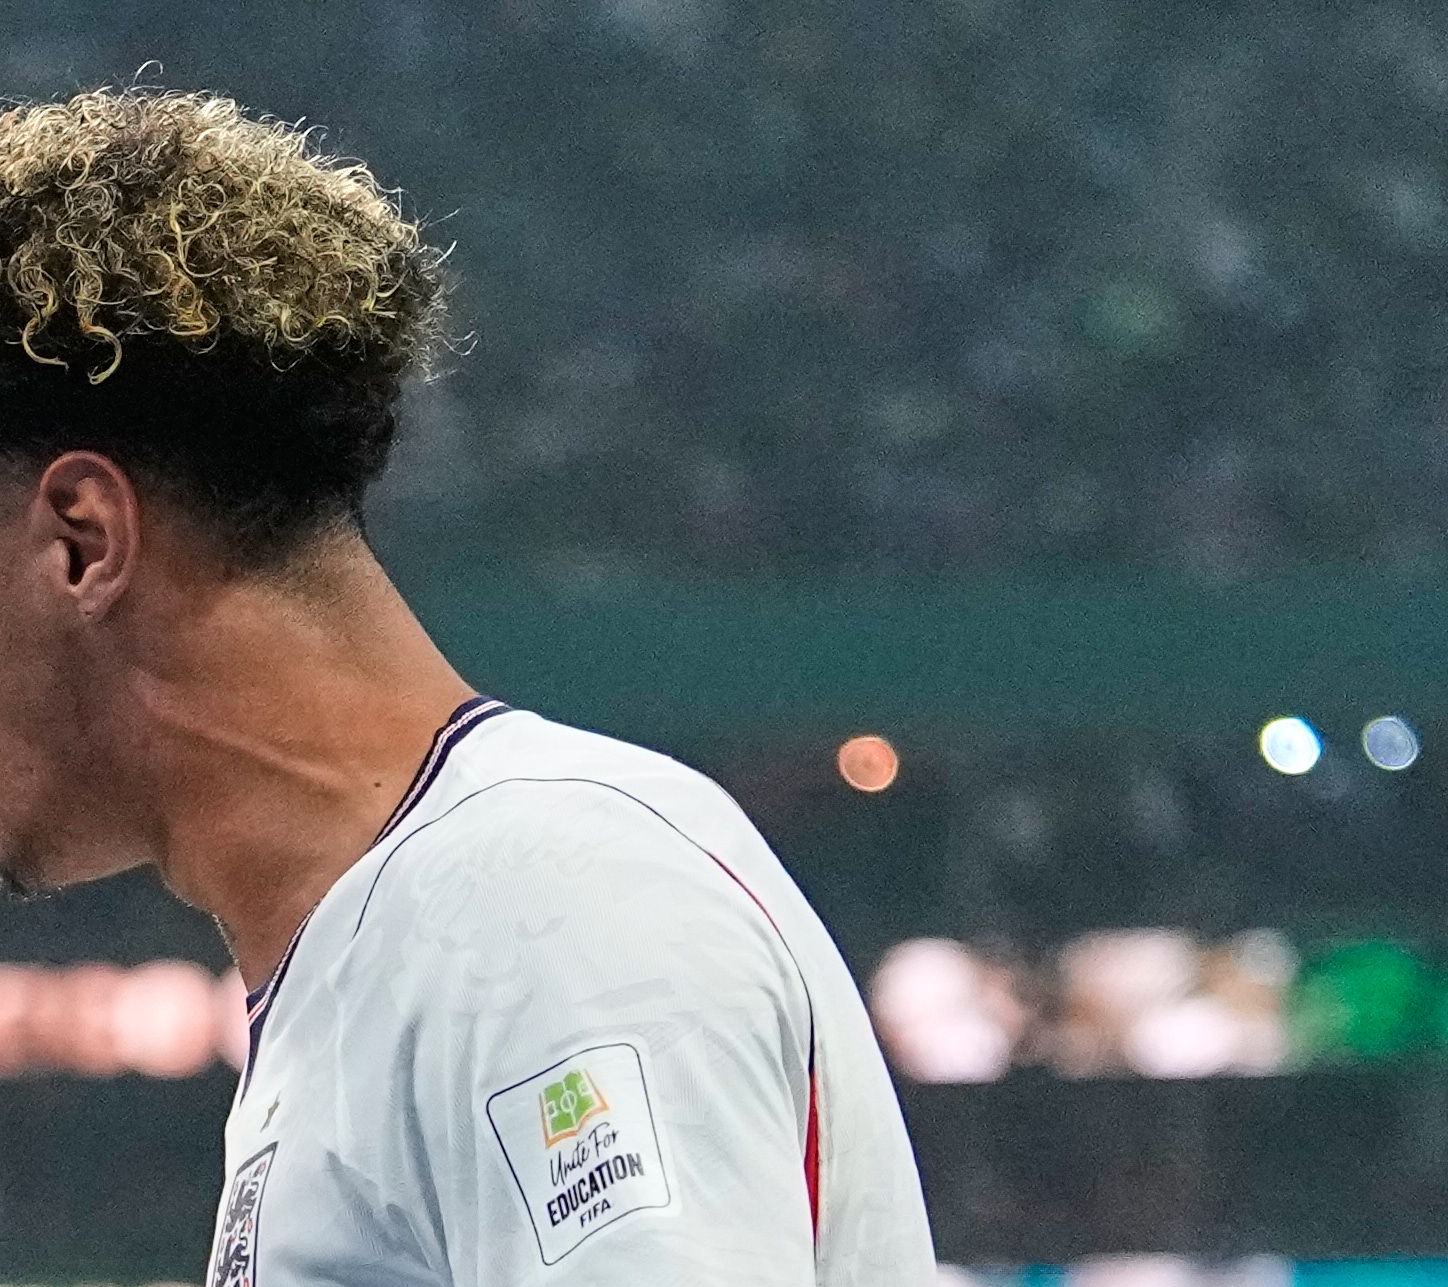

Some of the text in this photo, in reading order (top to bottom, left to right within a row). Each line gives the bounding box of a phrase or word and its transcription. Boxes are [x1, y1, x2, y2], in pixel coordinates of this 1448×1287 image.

[550, 1121, 619, 1187] Unite For
[547, 1152, 645, 1228] EDUCATION
[579, 1198, 612, 1228] FIFA
